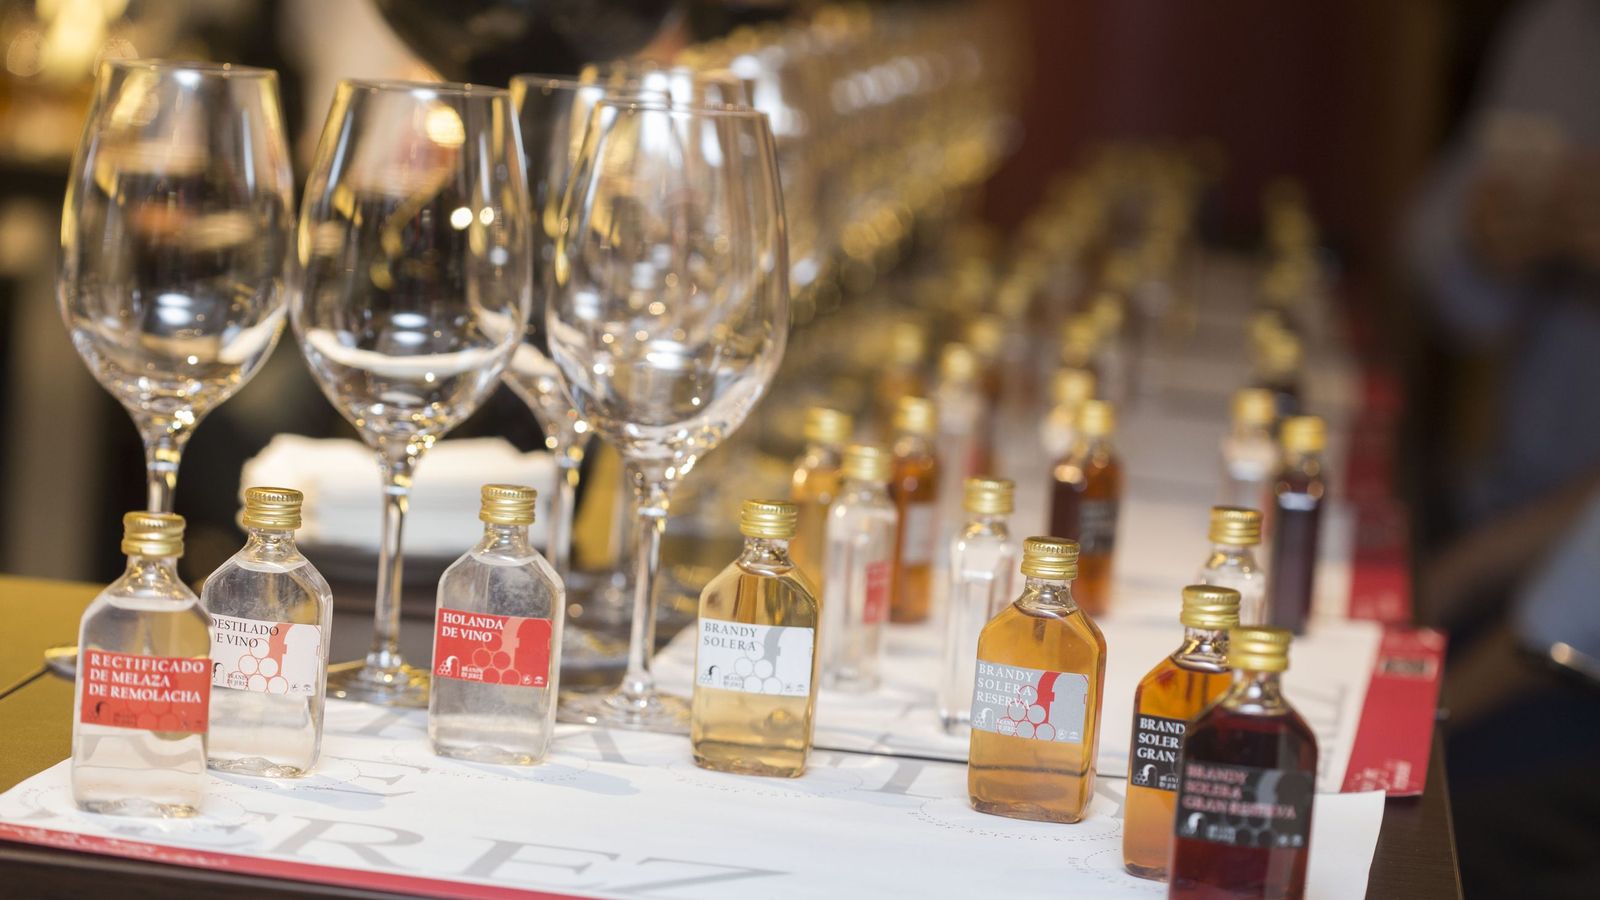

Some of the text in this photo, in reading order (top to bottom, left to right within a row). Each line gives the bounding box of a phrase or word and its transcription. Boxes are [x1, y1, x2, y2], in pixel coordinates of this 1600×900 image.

[442, 612, 504, 630] HOLANDA
[441, 626, 492, 642] DE VINO
[704, 622, 757, 638] BRANDY
[226, 634, 259, 648] VINO
[703, 636, 756, 652] SOLERA
[91, 653, 205, 673] RECTIFICADO
[90, 668, 171, 688] DE MELAZA
[979, 663, 1034, 682] BRANDY
[89, 683, 202, 703] DE REMOLACHA
[977, 677, 1032, 696] SOLERA
[976, 691, 1030, 710] RESERVA
[1140, 717, 1186, 734] BRAND
[1138, 732, 1183, 749] SOLER
[1136, 747, 1176, 763] GRAN
